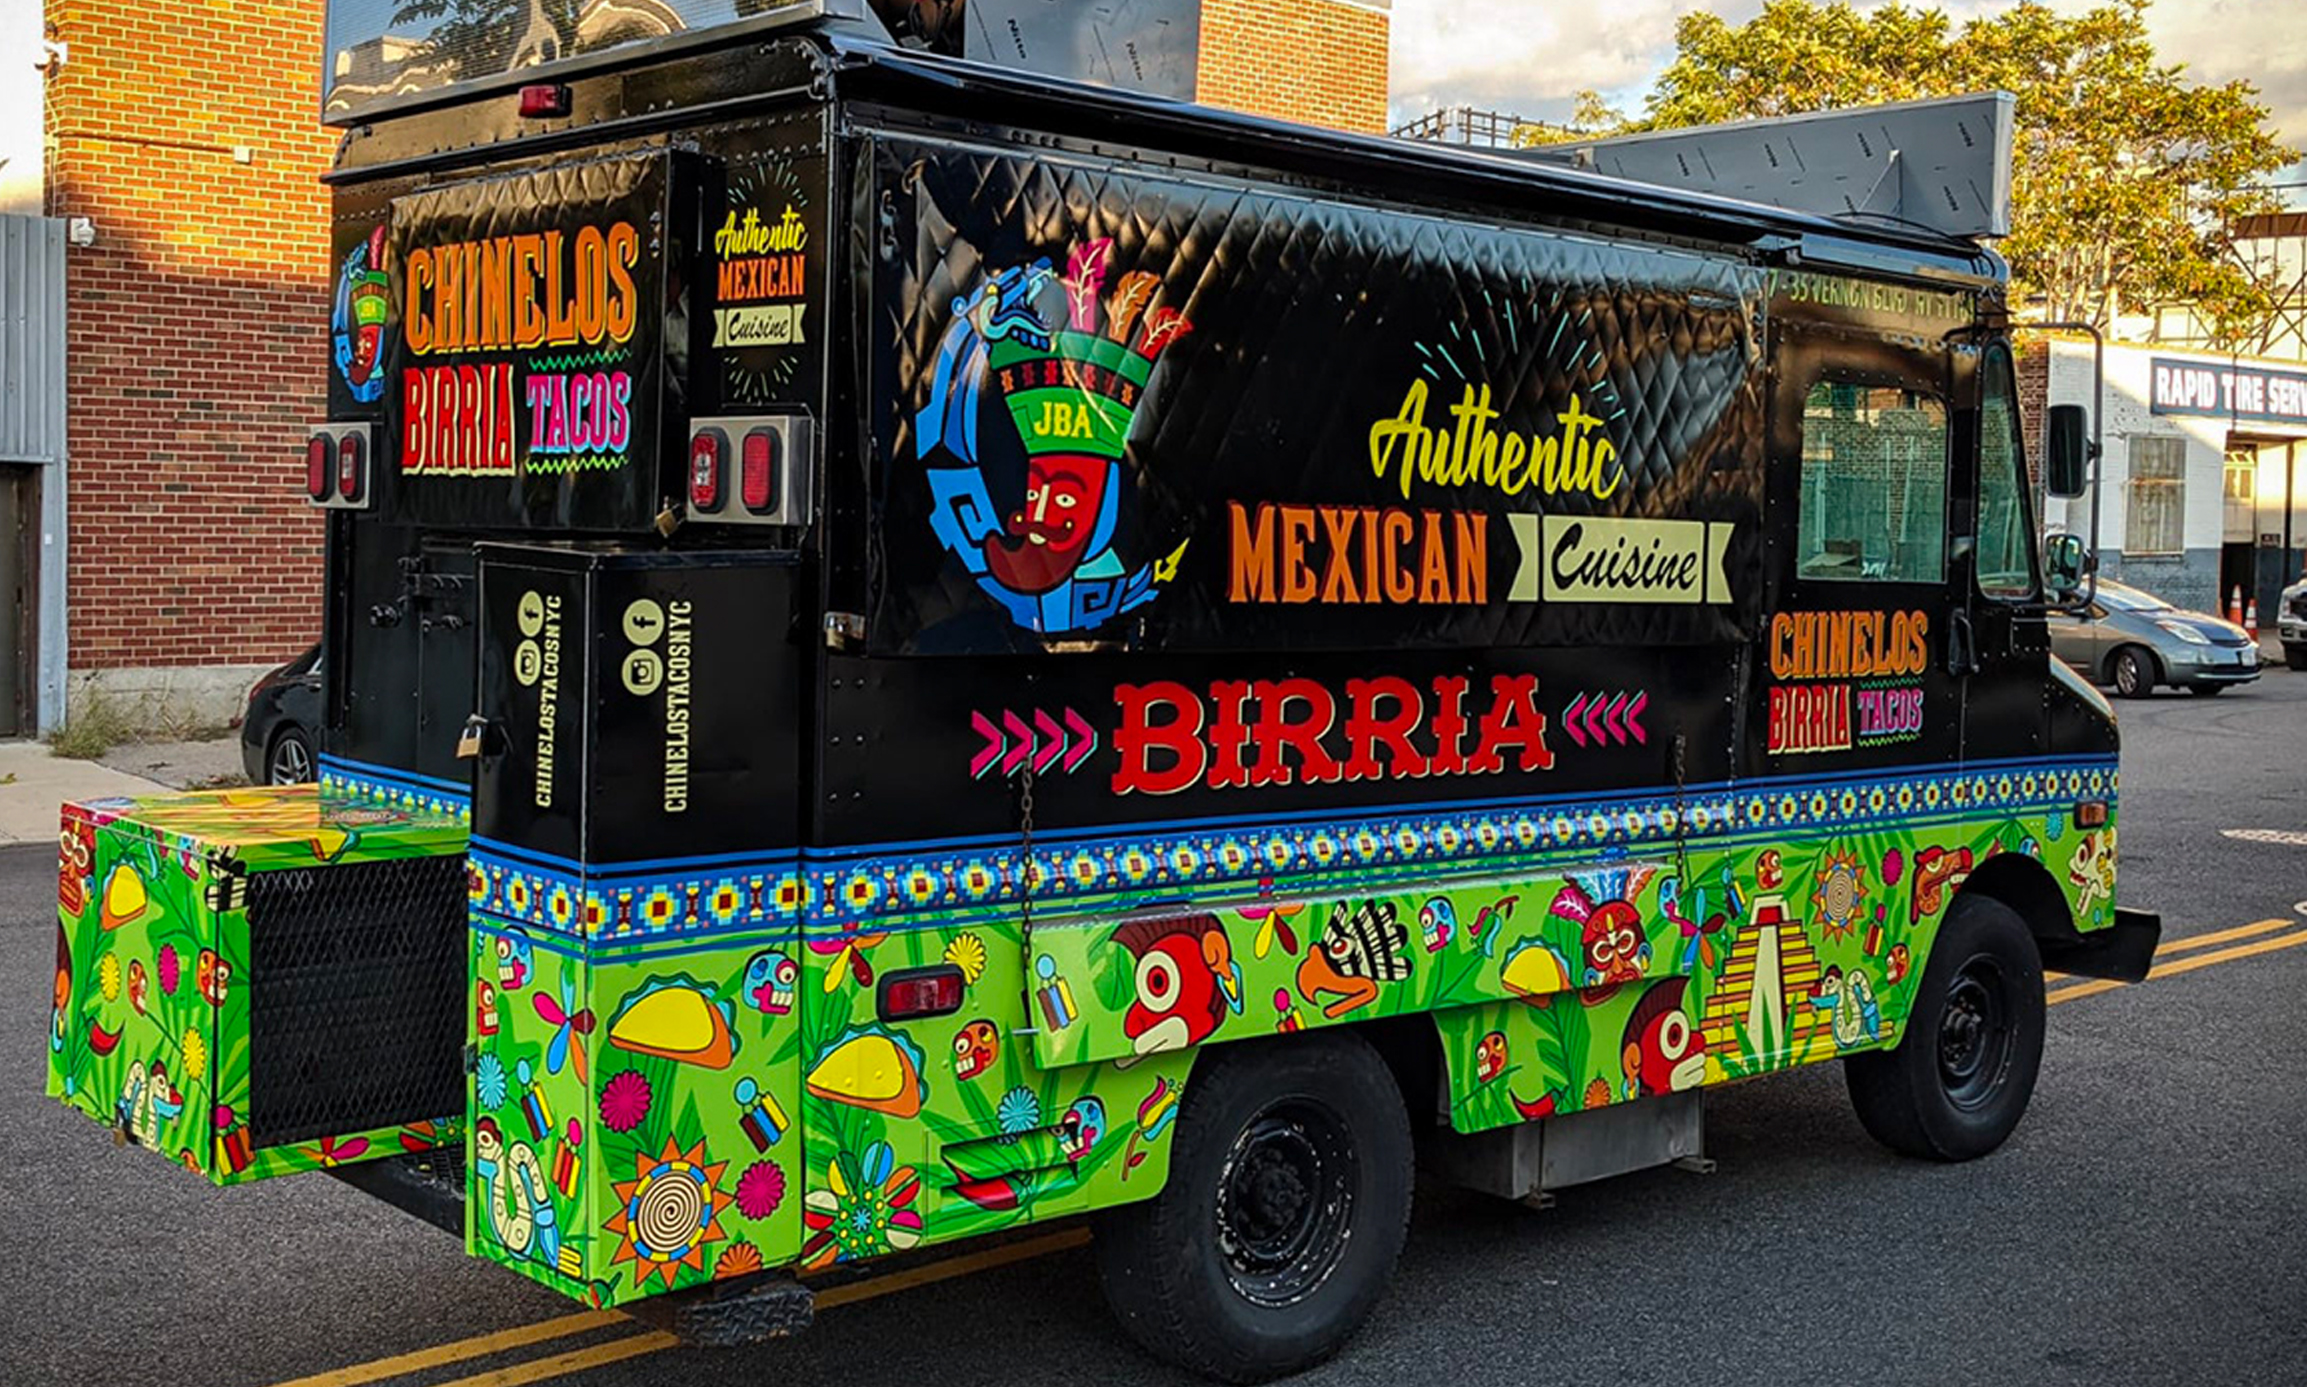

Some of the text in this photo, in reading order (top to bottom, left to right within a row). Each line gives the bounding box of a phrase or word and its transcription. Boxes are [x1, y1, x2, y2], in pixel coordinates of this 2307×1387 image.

[1008, 18, 1026, 59] Nitto
[714, 203, 809, 262] Authentic
[404, 220, 641, 357] CHINELOS
[717, 255, 806, 302] MEXICAN
[1811, 273, 1869, 309] VERNON
[727, 310, 790, 343] Cuisine
[402, 362, 632, 477] BIRRIA TACOS
[1033, 401, 1094, 439] JBA
[2155, 366, 2218, 411] RAPID
[2220, 371, 2265, 414] TIRE
[1368, 377, 1625, 500] Authentic
[1226, 500, 1699, 604] MEXICAN Cuisine
[1770, 609, 1929, 680] CHINELOS
[536, 595, 562, 807] CHINELOSTACOSNYC
[664, 601, 691, 812] CHINELOSTACOSNYC
[1111, 673, 1556, 796] BIRRIA
[1767, 684, 1924, 755] BIRRIA TACOS
